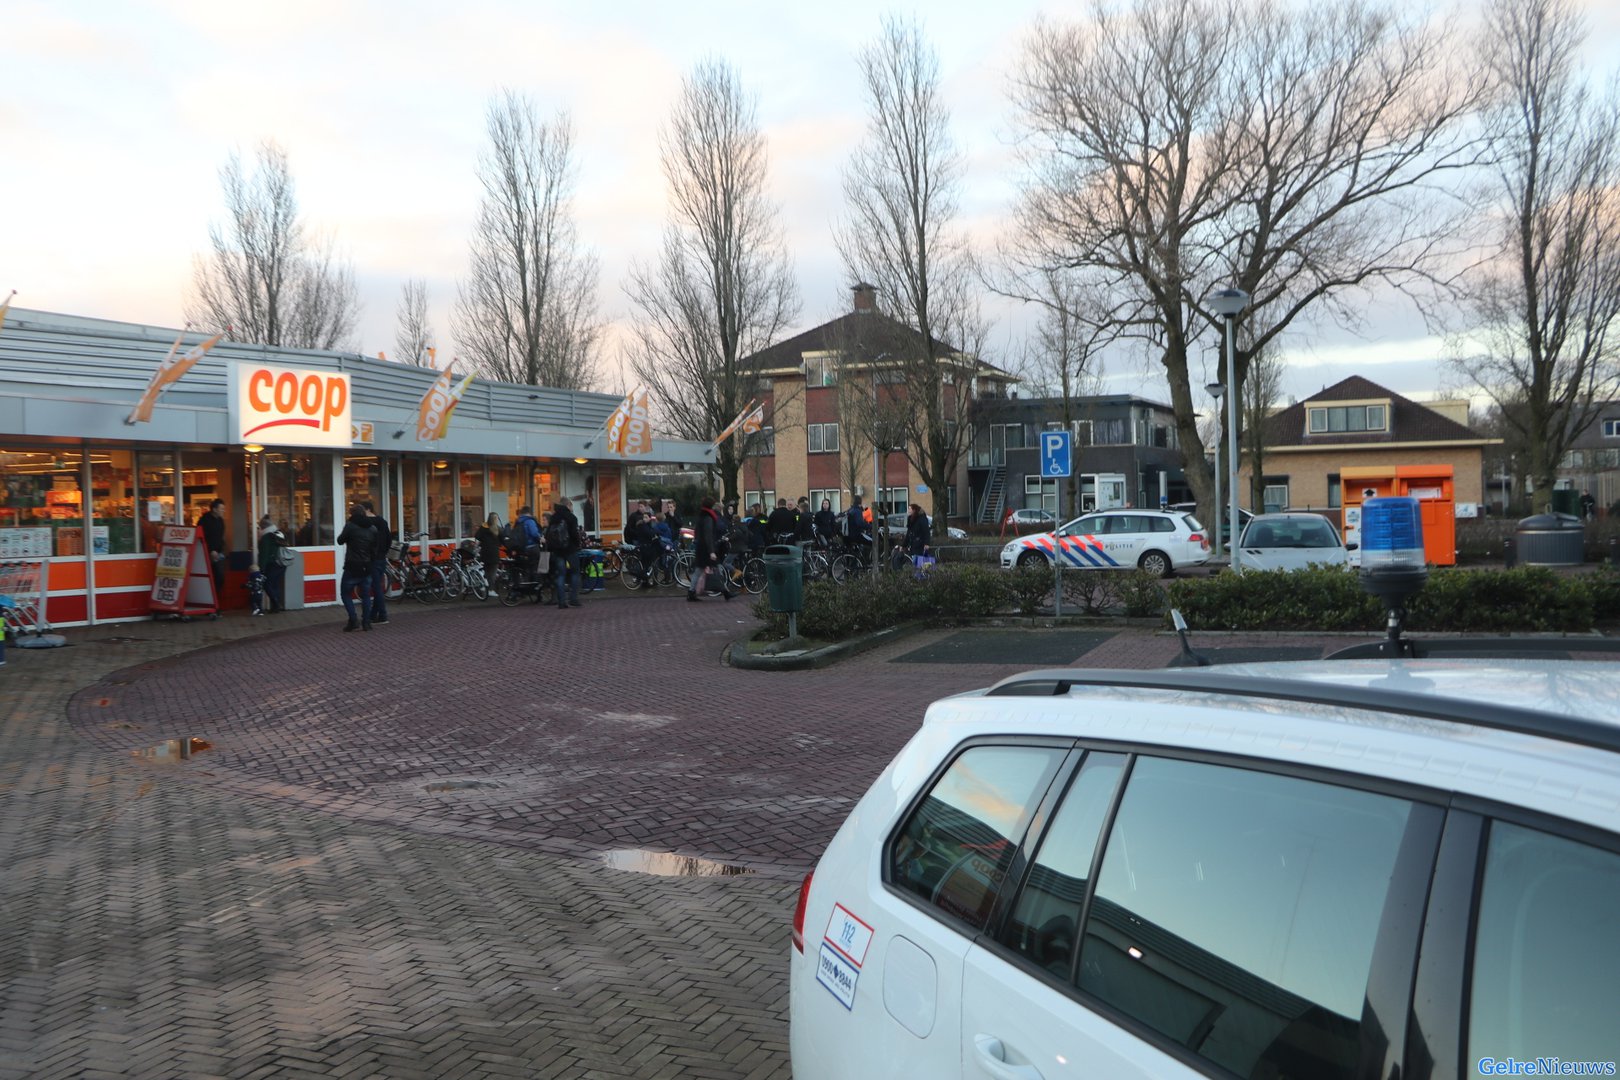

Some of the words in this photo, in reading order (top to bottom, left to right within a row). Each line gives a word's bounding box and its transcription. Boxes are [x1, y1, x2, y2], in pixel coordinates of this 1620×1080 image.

[249, 369, 347, 432] coop
[1047, 435, 1064, 458] P
[841, 921, 856, 944] 112
